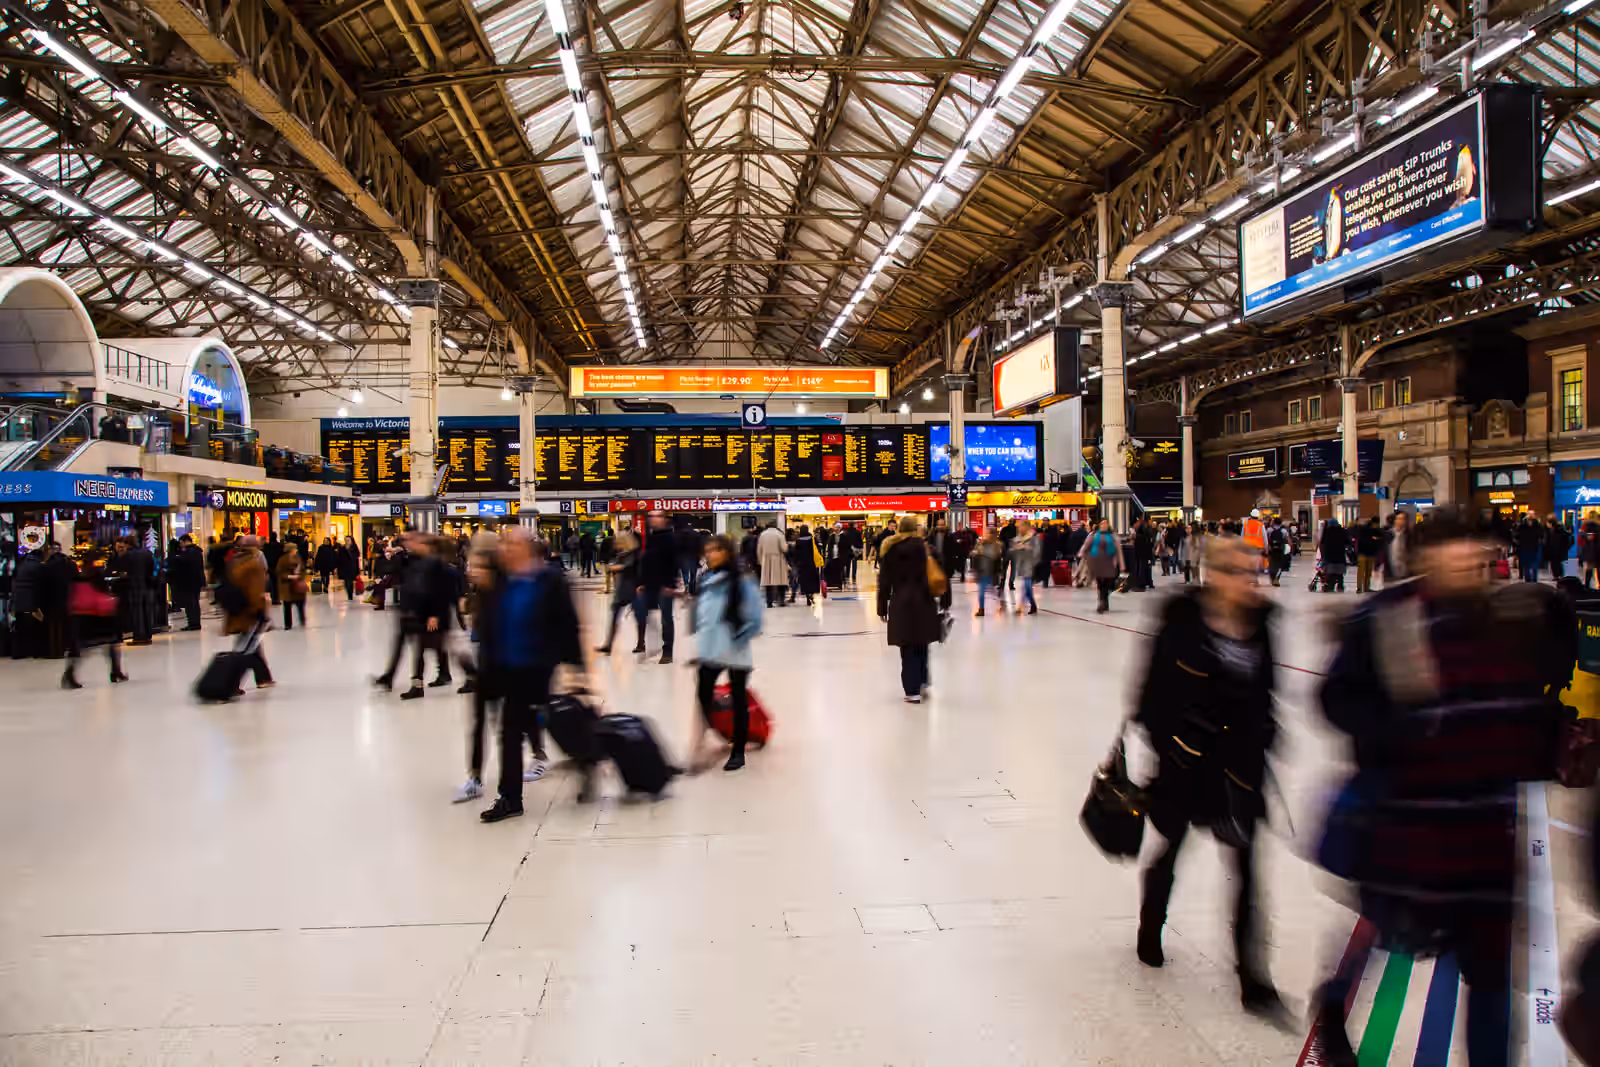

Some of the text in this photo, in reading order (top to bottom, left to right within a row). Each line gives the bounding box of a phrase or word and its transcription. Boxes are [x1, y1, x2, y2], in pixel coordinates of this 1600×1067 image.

[1344, 139, 1453, 201] Our cost saving SIP Trunks
[1344, 157, 1447, 214] enable you to divert your
[1344, 171, 1448, 226] telephone calls wherever
[1345, 176, 1466, 243] you wish, whenever you wish
[331, 418, 409, 429] Welcome to Victoria
[985, 447, 996, 456] YOU
[75, 480, 154, 501] NERO EXPRESS
[227, 490, 267, 508] MONSOON
[562, 502, 571, 511] 12
[654, 500, 706, 510] BURGER
[848, 498, 867, 509] GX
